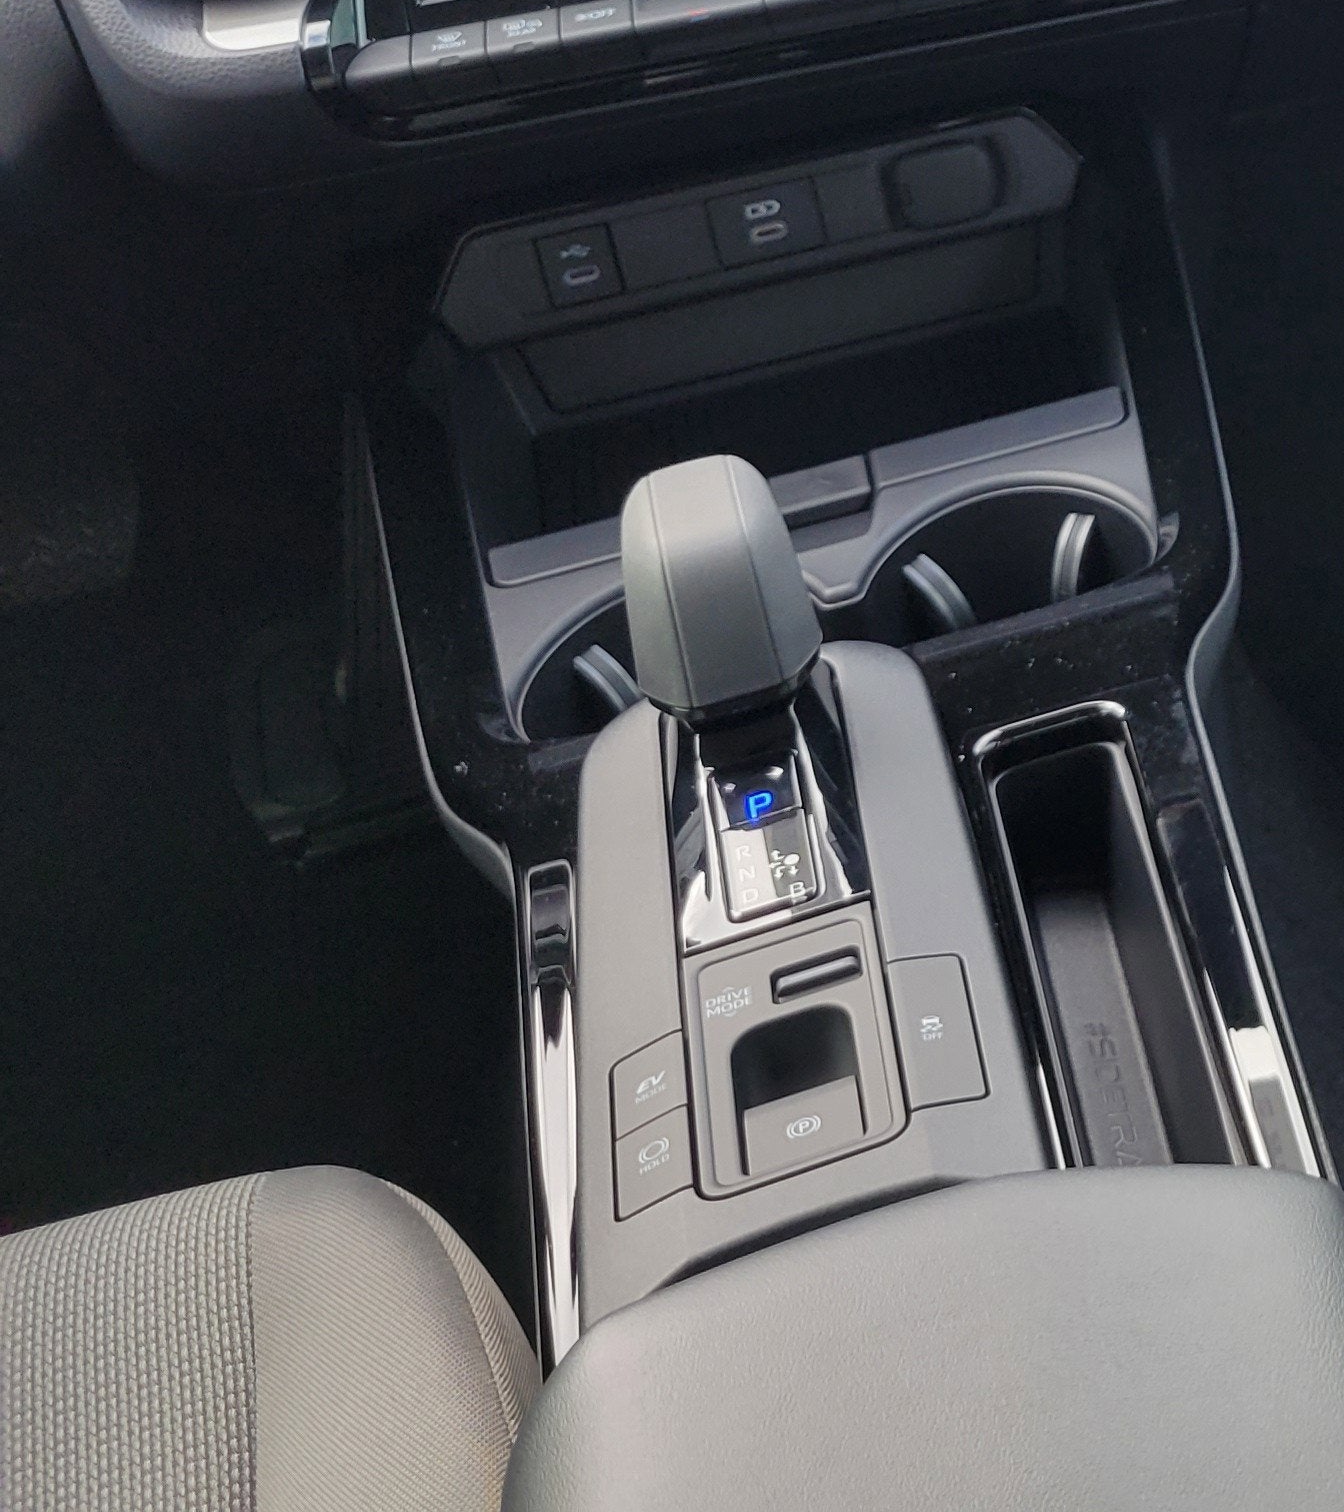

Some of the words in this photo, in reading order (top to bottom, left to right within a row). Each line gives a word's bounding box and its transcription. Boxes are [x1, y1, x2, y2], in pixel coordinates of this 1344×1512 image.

[747, 791, 773, 819] P
[736, 845, 752, 862] R
[740, 866, 756, 882] N
[742, 888, 759, 905] D
[790, 881, 806, 898] B
[705, 986, 752, 1009] DRIVE
[706, 997, 752, 1019] MODE
[636, 1070, 666, 1095] EV
[640, 1153, 670, 1176] HOLD
